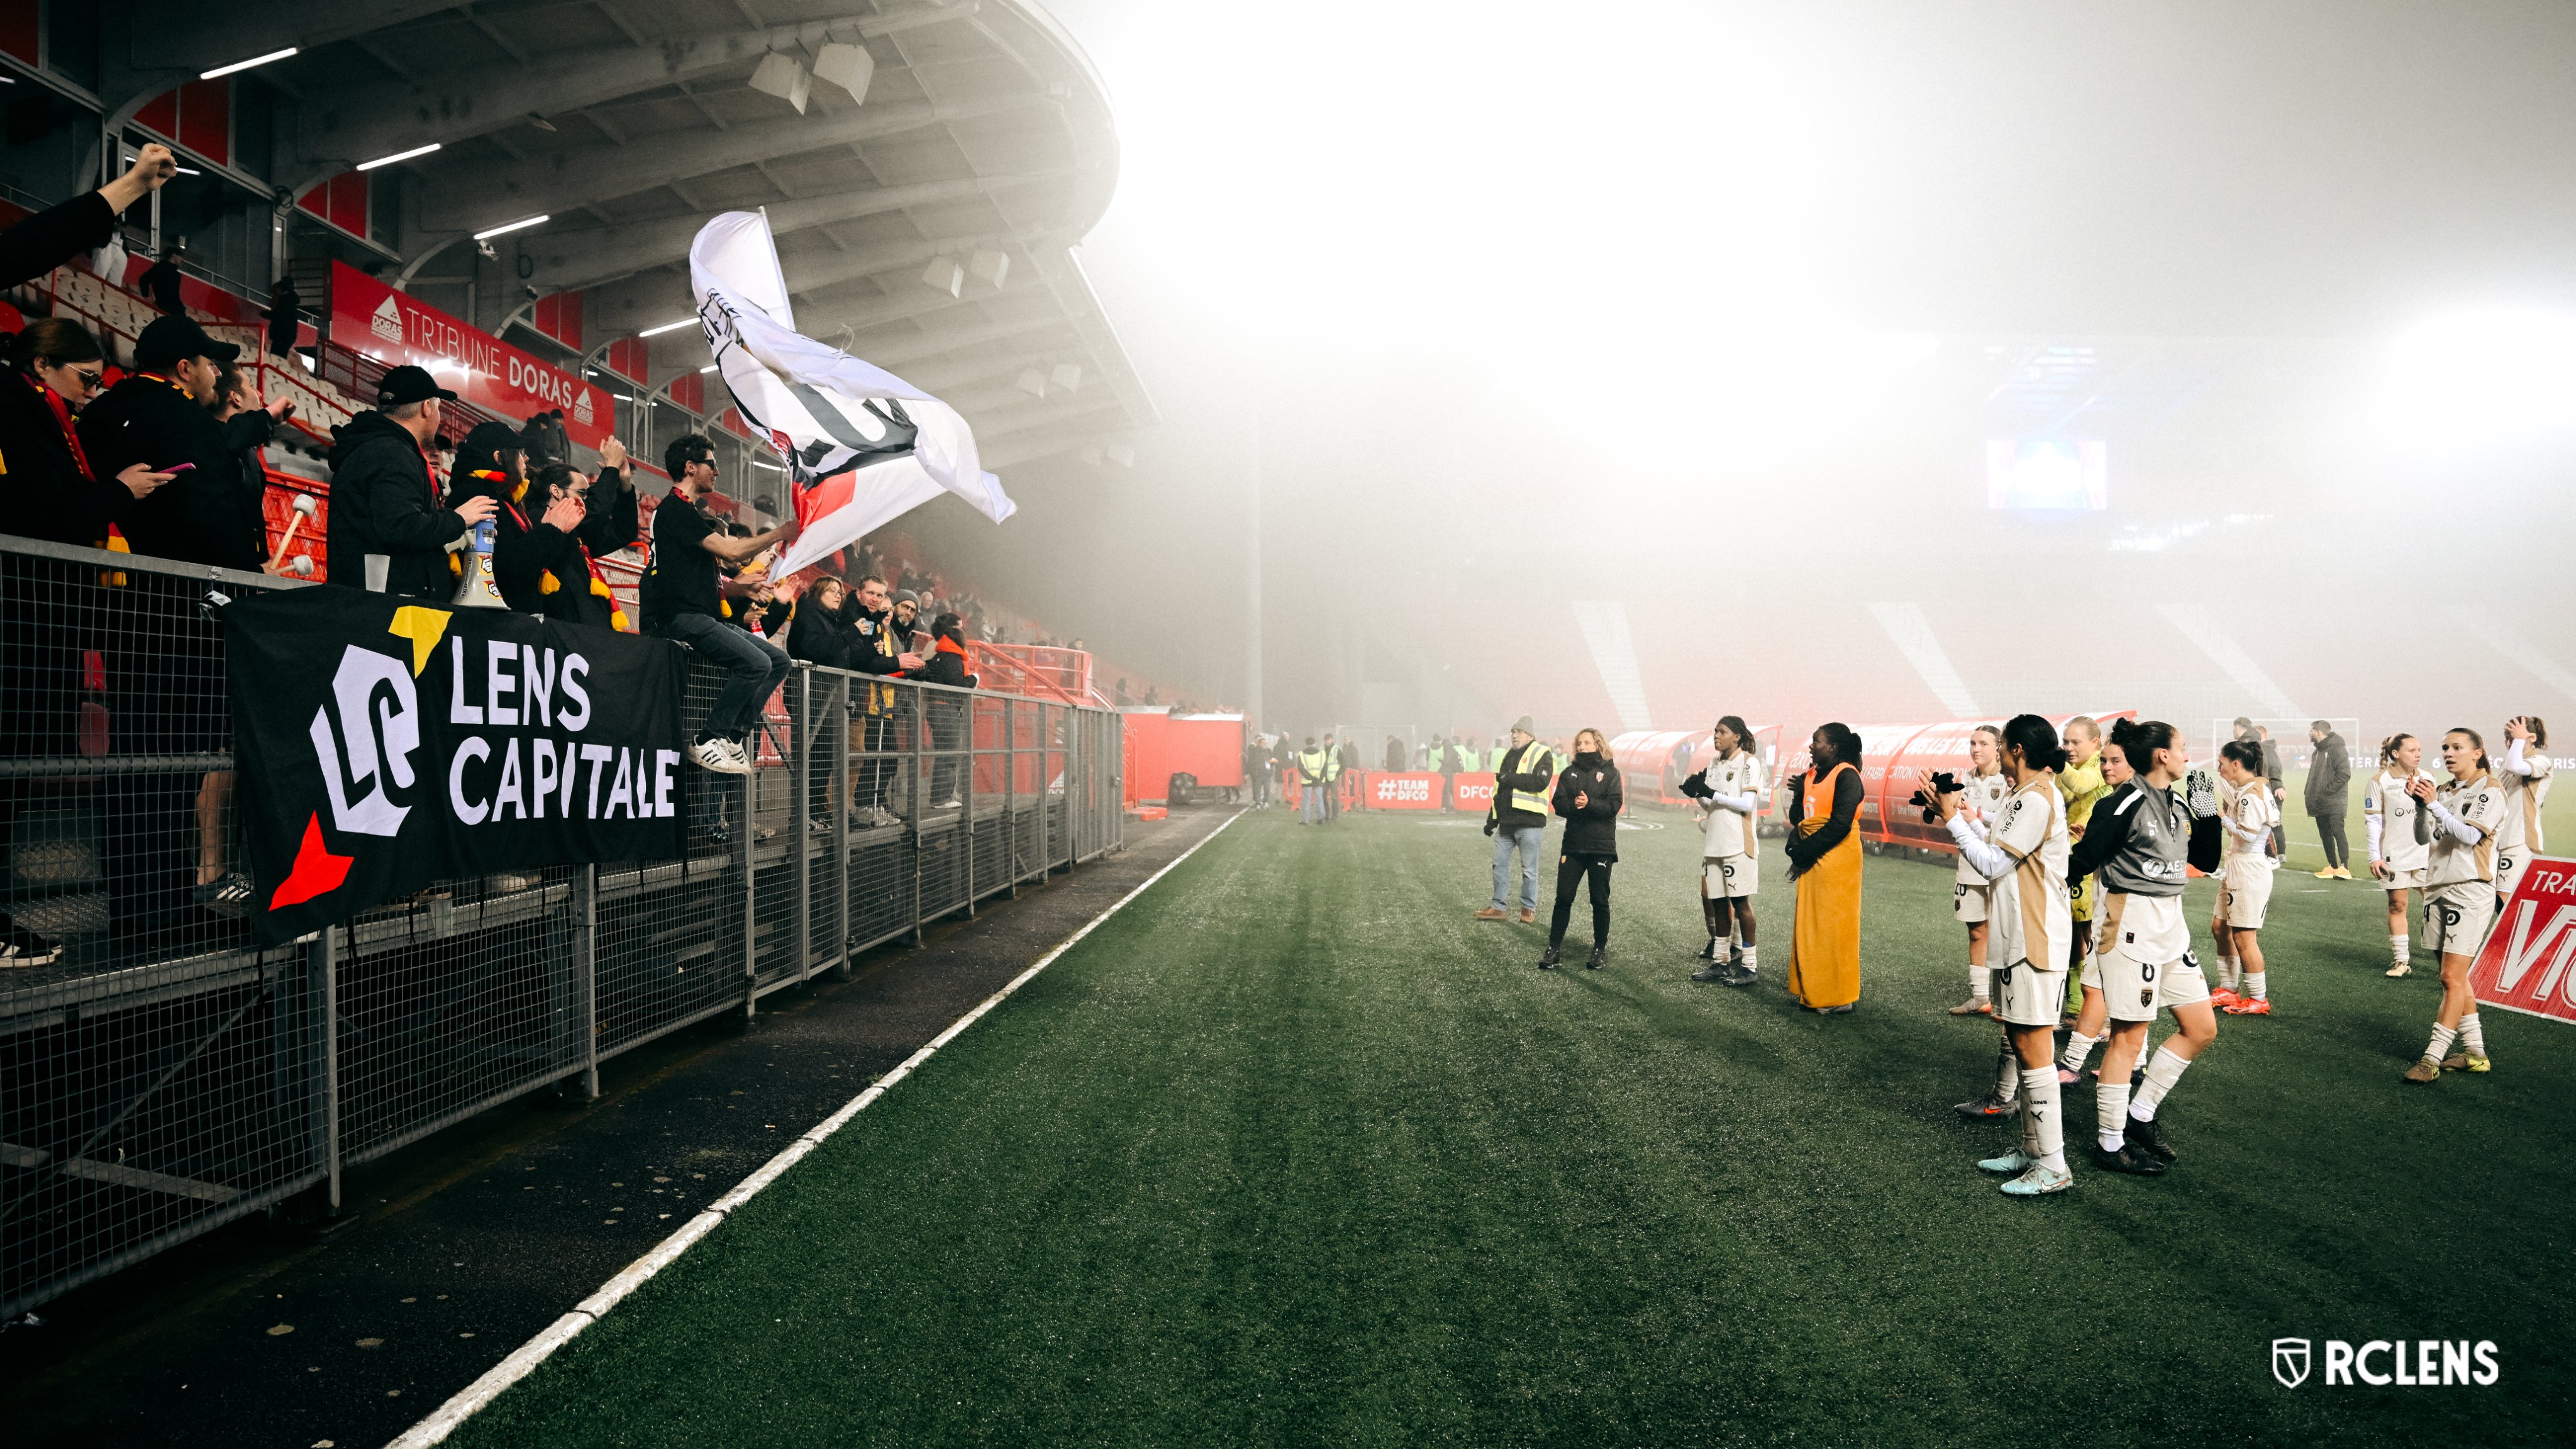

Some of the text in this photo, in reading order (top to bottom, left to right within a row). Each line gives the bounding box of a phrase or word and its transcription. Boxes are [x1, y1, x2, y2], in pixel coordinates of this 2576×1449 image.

[372, 315, 402, 335] DORAS
[406, 308, 572, 409] TRIBUNE DORAS
[575, 404, 593, 419] DORAS
[450, 635, 590, 732] LENS
[449, 736, 680, 825] CAPITALE
[1397, 790, 1429, 801] DFCO
